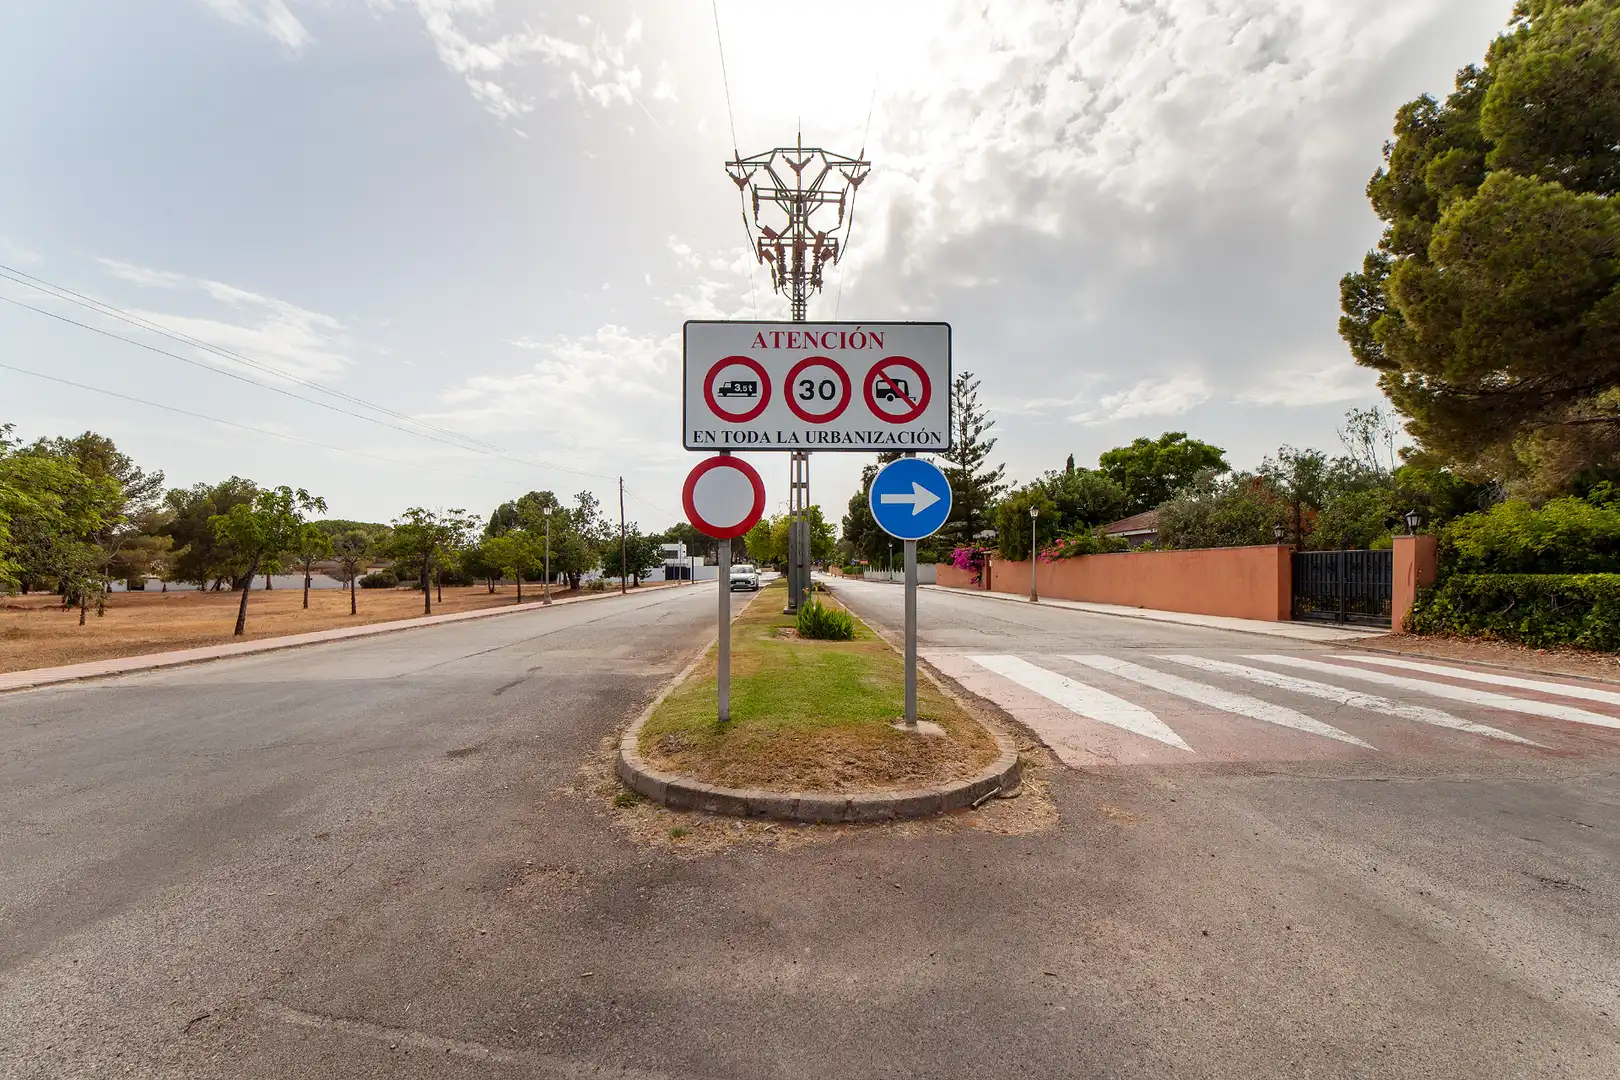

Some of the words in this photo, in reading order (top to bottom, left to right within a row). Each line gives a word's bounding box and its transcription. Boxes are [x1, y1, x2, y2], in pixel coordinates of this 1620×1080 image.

[751, 326, 885, 350] ATENCIÓN
[798, 379, 836, 401] 30
[693, 430, 716, 444] EN
[721, 430, 772, 444] TODA
[777, 431, 800, 444] LA
[805, 428, 942, 446] URBANIZACIÓN
